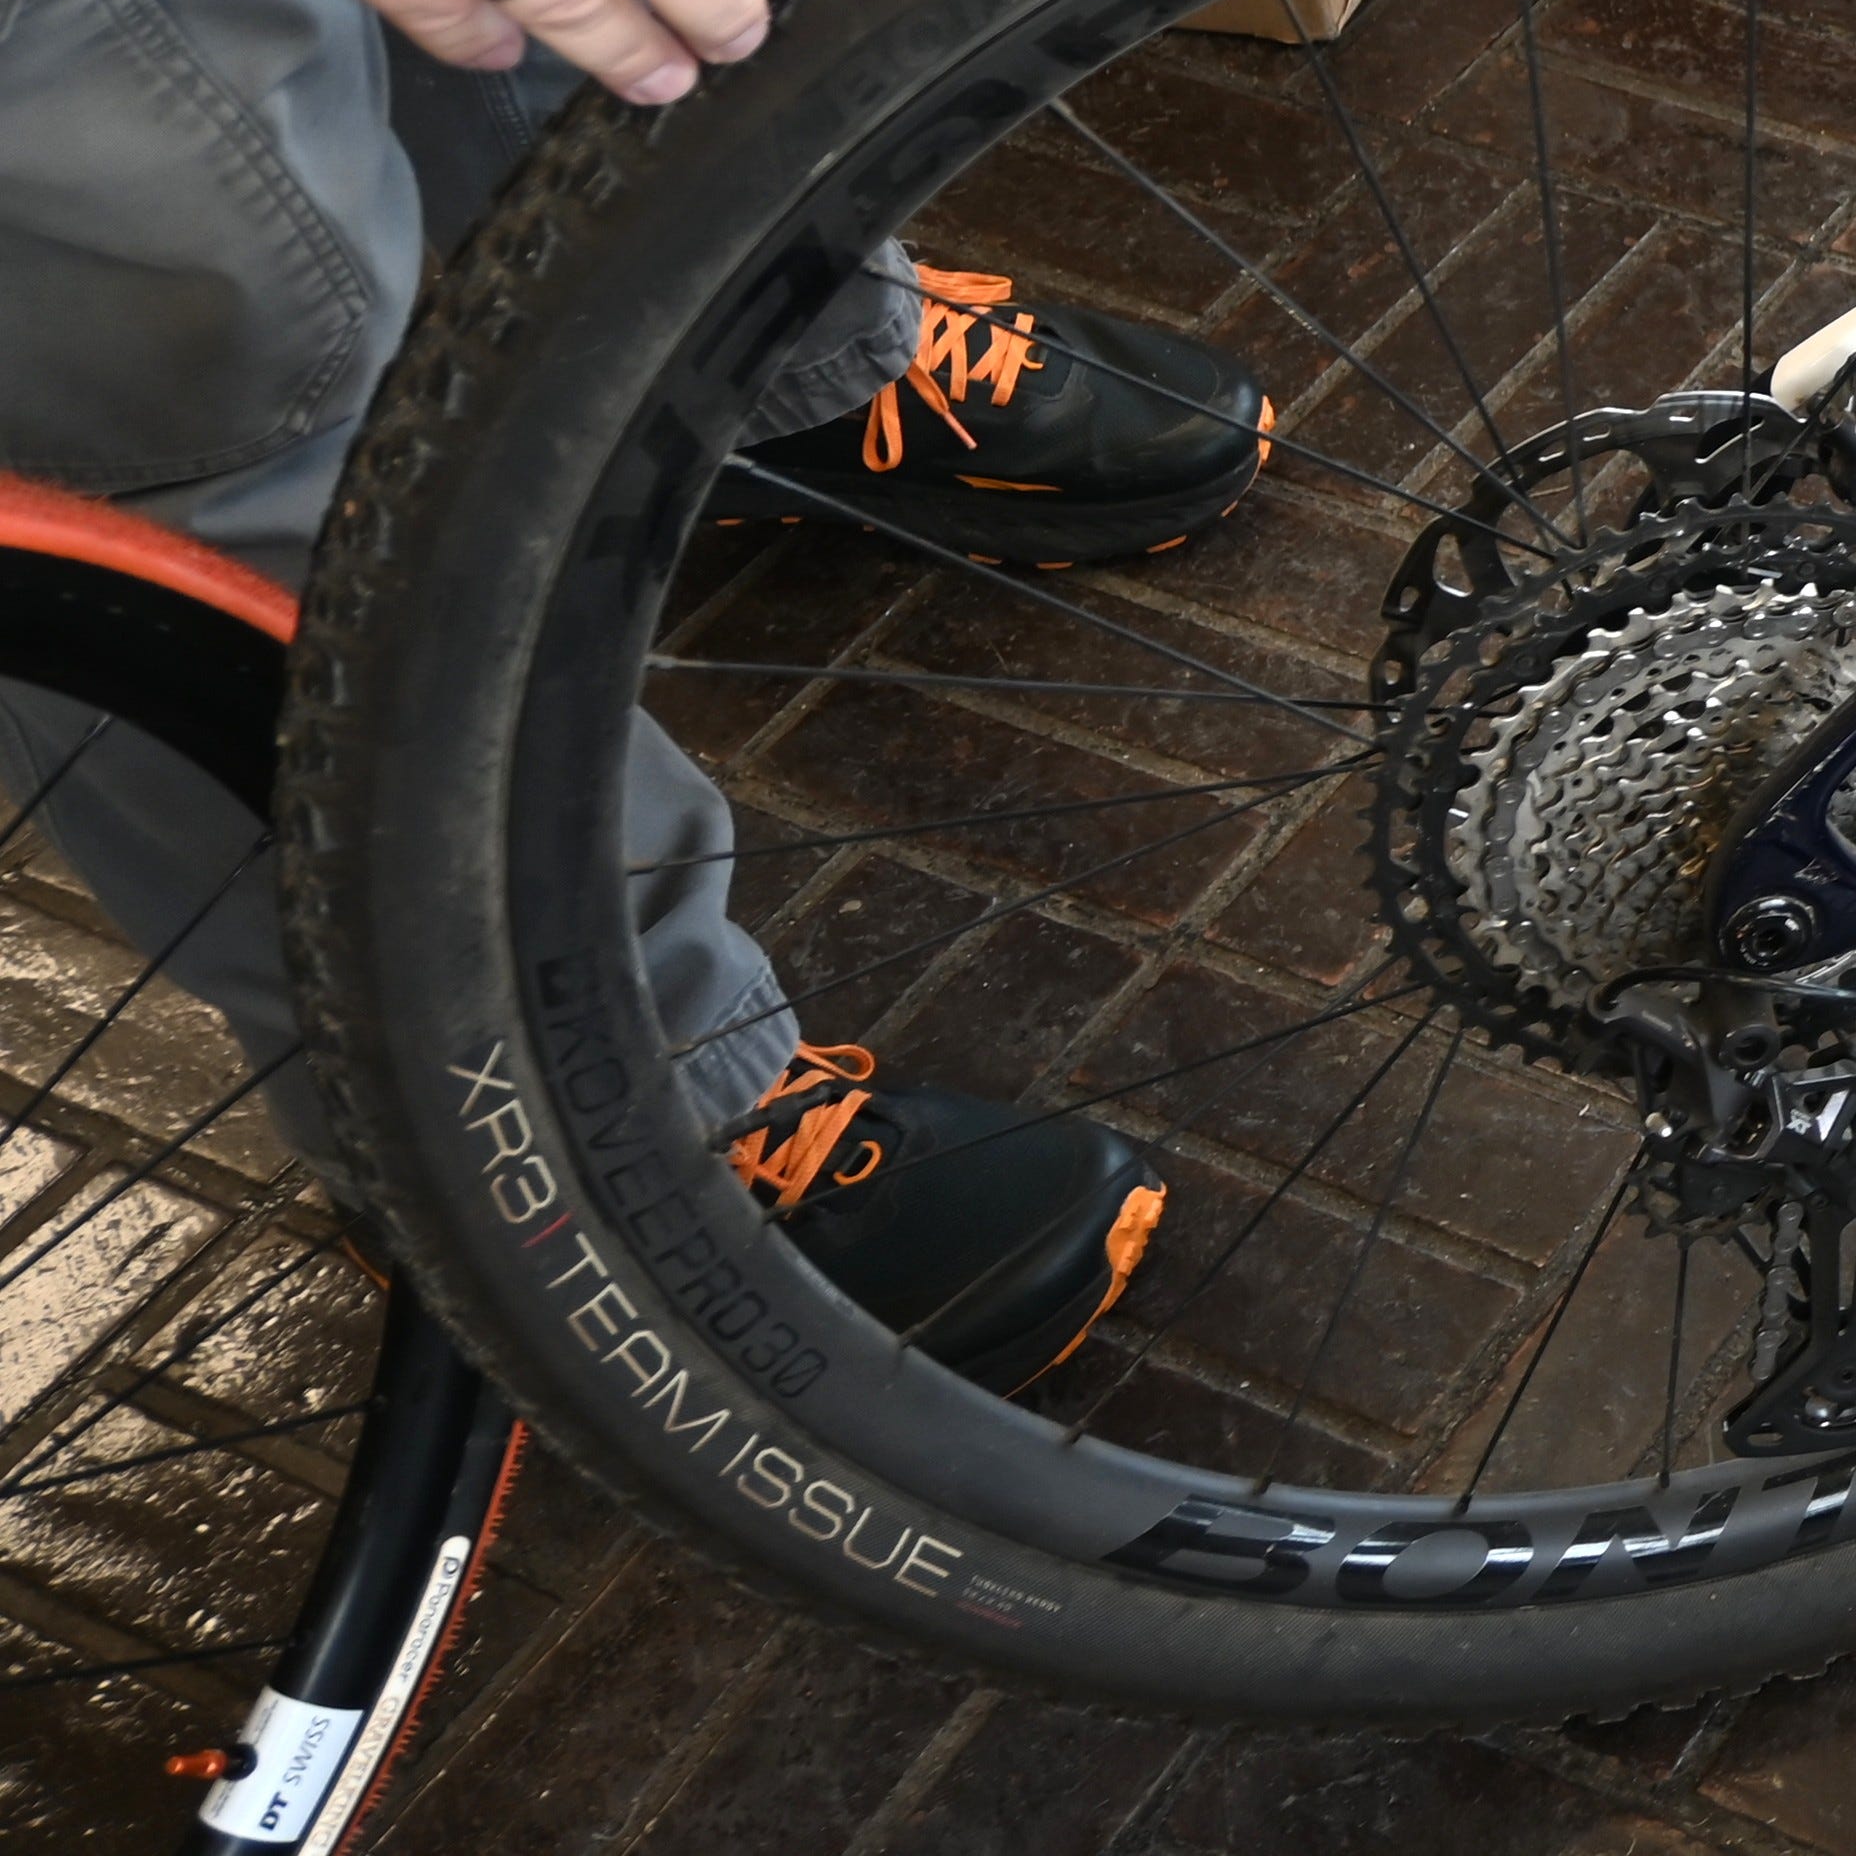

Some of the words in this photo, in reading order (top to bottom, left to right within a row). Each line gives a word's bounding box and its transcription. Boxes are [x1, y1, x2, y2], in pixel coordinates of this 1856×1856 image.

[446, 1040, 557, 1225] XR3
[547, 1230, 731, 1453] TEAM
[718, 1431, 963, 1598] ISSUE
[400, 1581, 452, 1682] Panaracer
[258, 1791, 289, 1831] DT
[284, 1716, 331, 1789] SWISS
